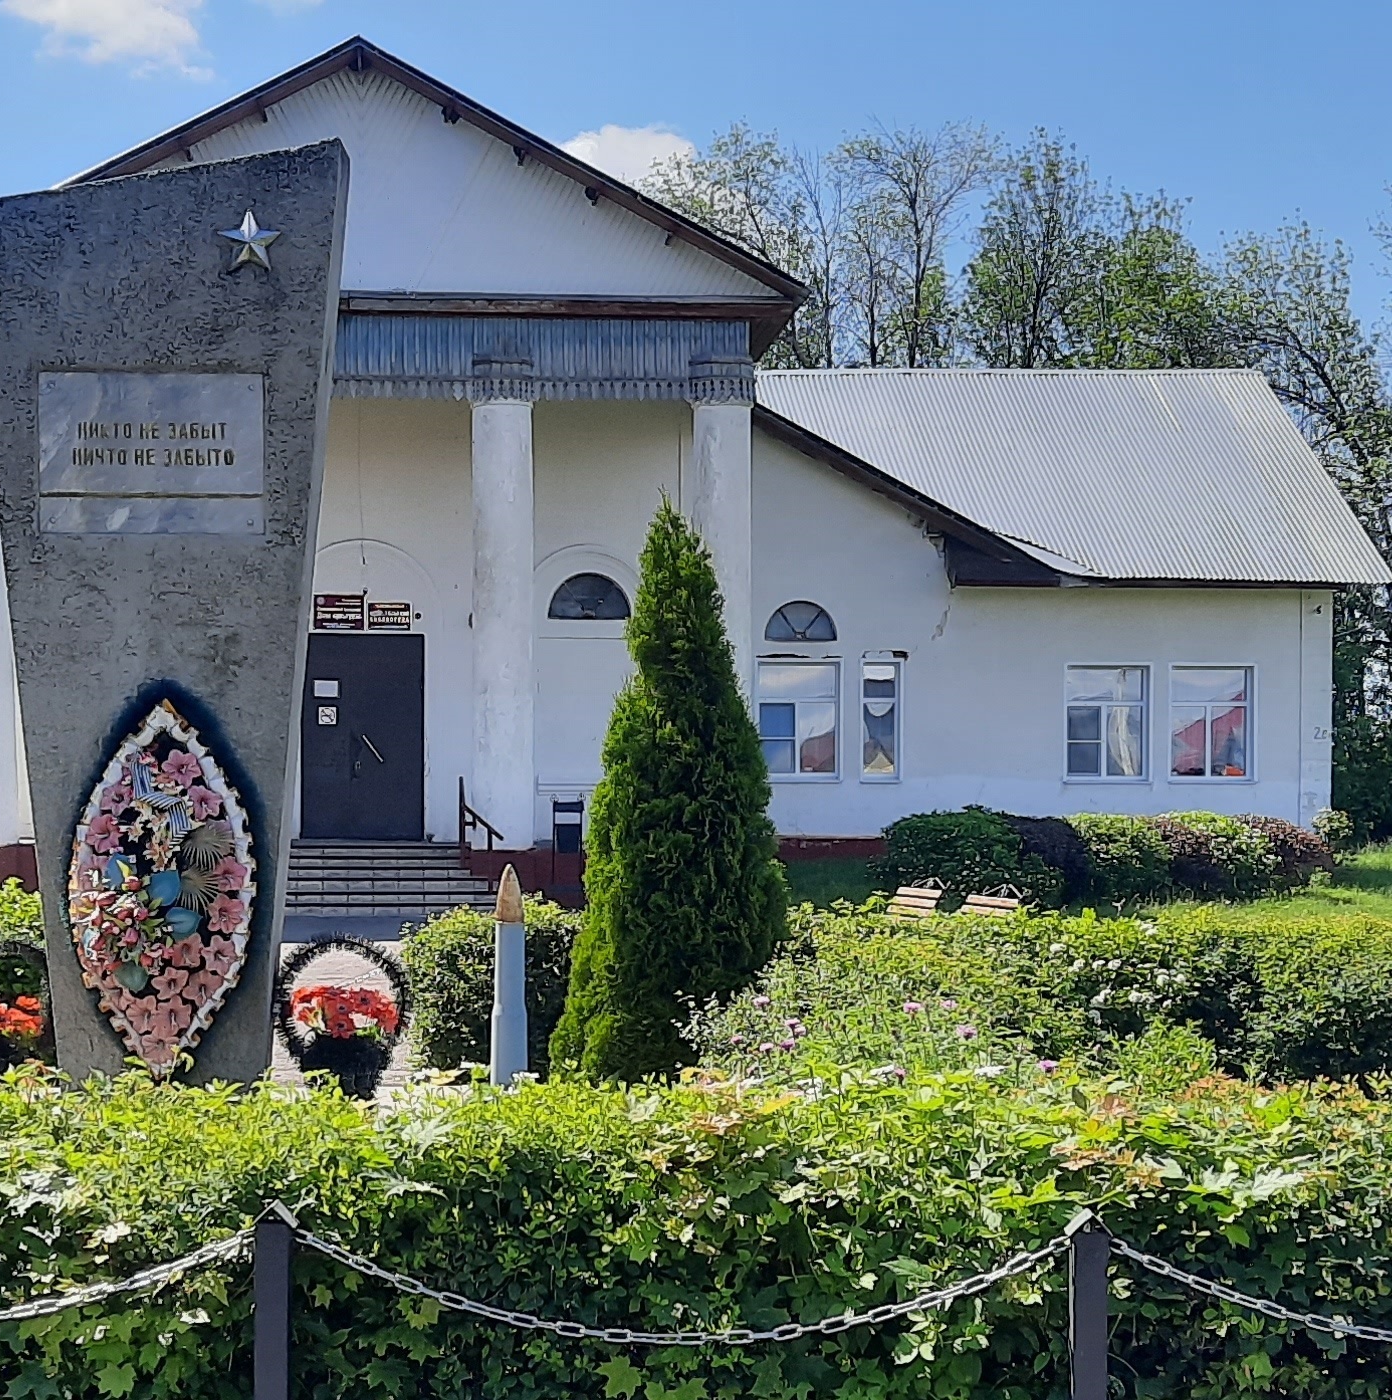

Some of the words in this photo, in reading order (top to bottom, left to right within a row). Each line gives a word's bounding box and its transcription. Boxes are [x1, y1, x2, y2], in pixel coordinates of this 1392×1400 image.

[77, 421, 132, 440] НИКТО
[139, 421, 160, 440] НЕ
[168, 422, 227, 440] ЗАБЫТ
[72, 447, 127, 466] НИЧТО
[134, 447, 156, 466] НЕ
[163, 447, 236, 467] ЗАБЫТО
